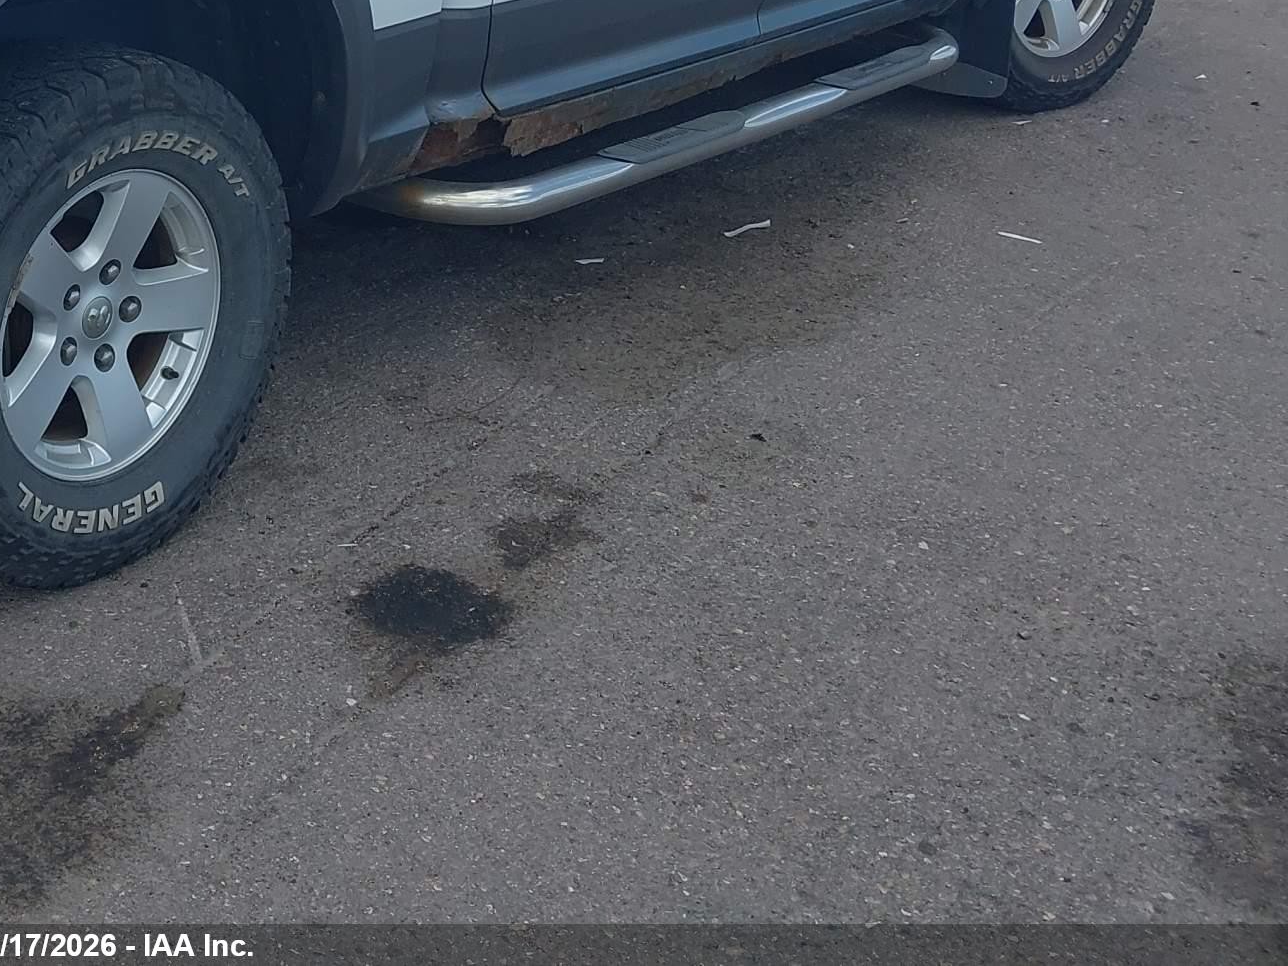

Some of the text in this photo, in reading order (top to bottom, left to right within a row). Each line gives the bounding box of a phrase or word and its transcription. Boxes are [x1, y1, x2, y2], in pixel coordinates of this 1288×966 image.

[66, 130, 251, 198] GRABBER A/T
[17, 480, 166, 535] GENERAL
